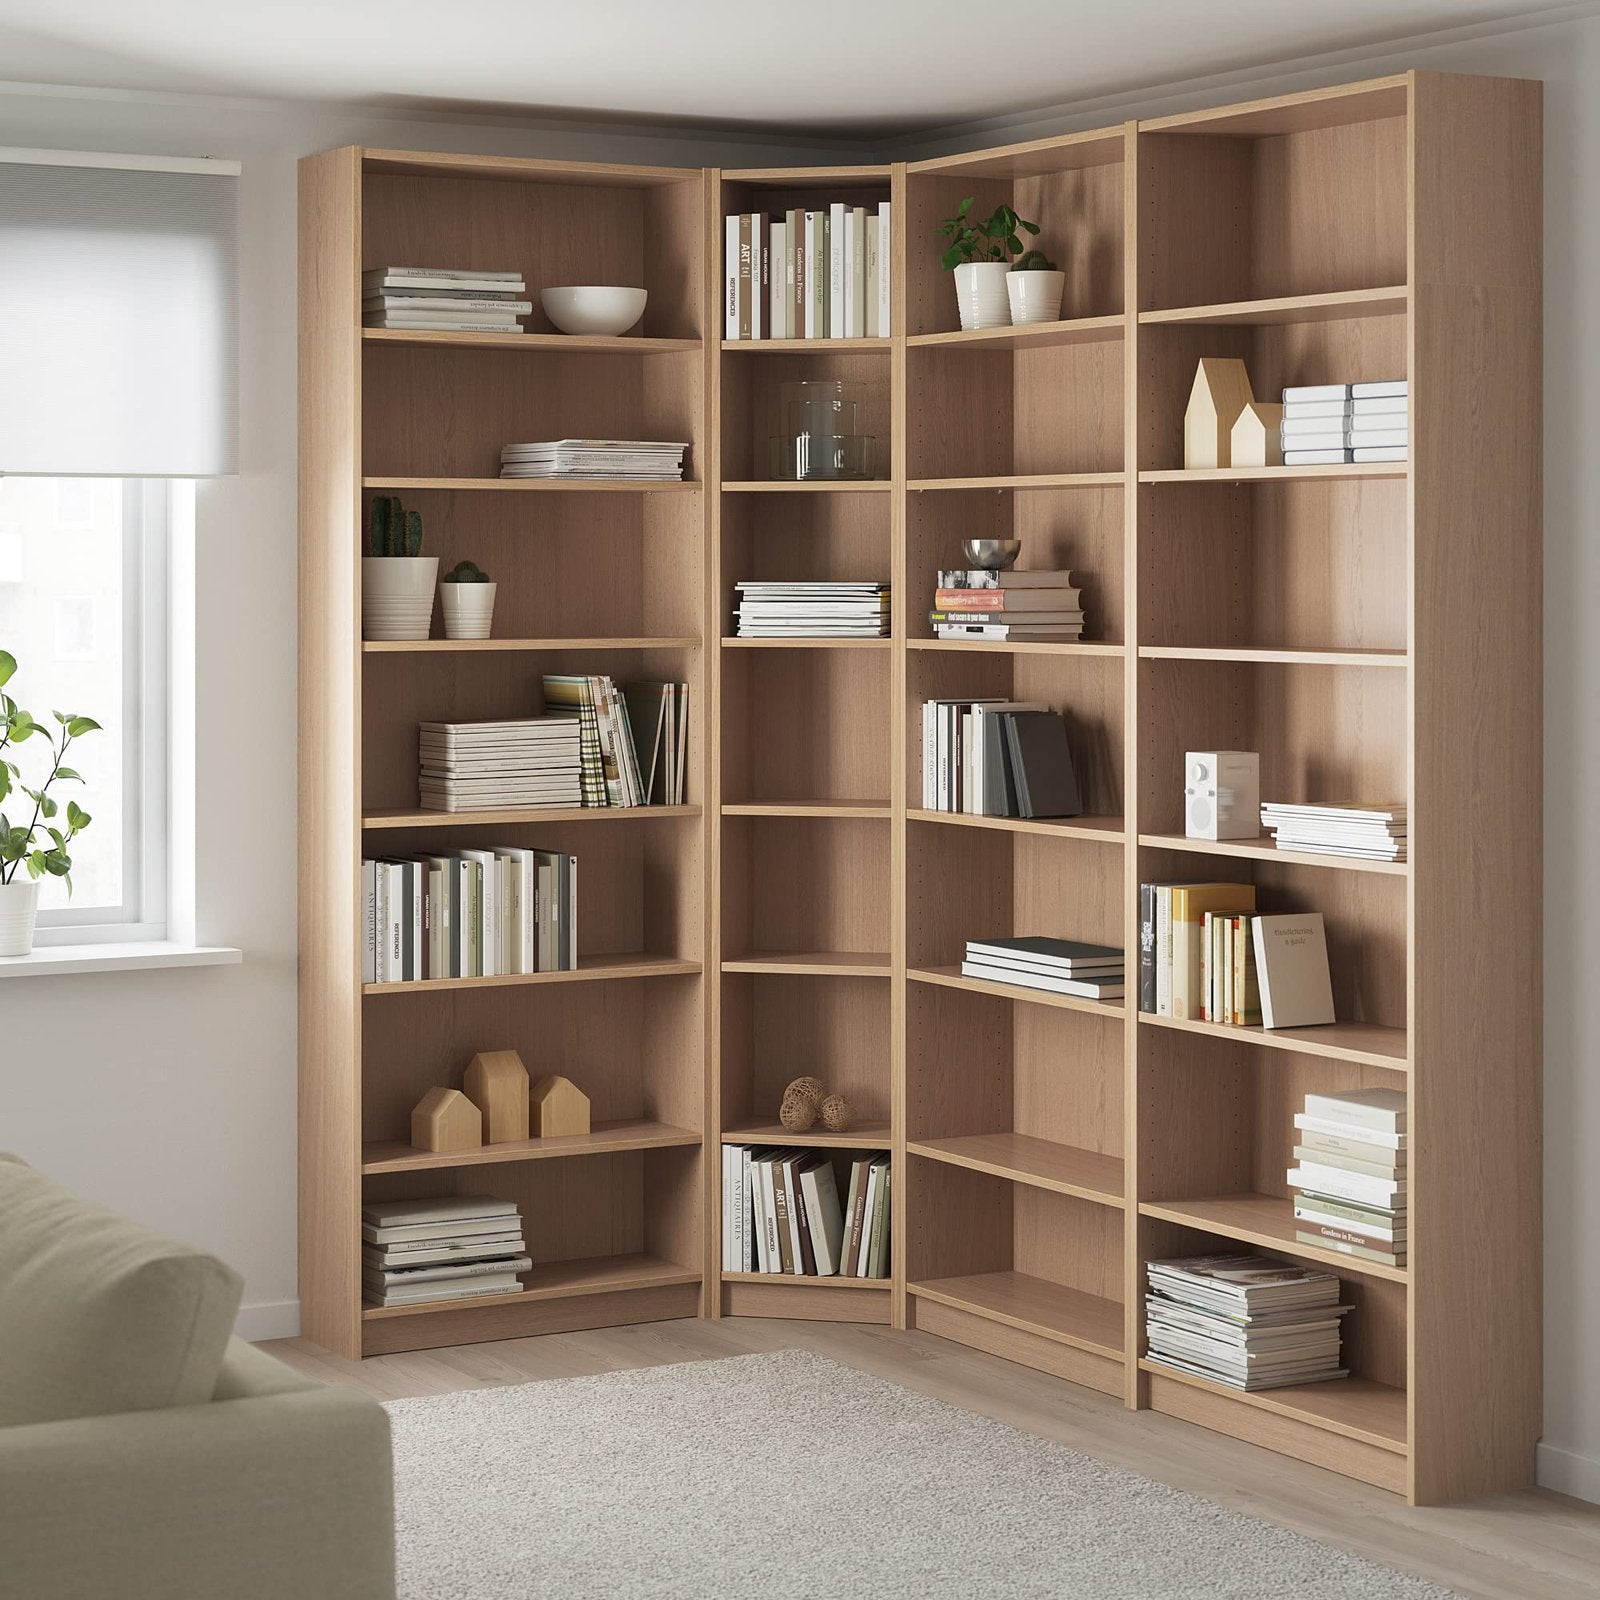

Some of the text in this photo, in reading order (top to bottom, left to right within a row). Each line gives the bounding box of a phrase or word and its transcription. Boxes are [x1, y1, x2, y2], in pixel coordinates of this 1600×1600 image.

[741, 243, 751, 264] ART
[776, 1188, 786, 1207] ART
[855, 1196, 863, 1220] Gardens
[733, 1179, 741, 1240] ANTIQUAIRES
[1321, 1227, 1341, 1239] Gardens
[1348, 1233, 1365, 1245] France
